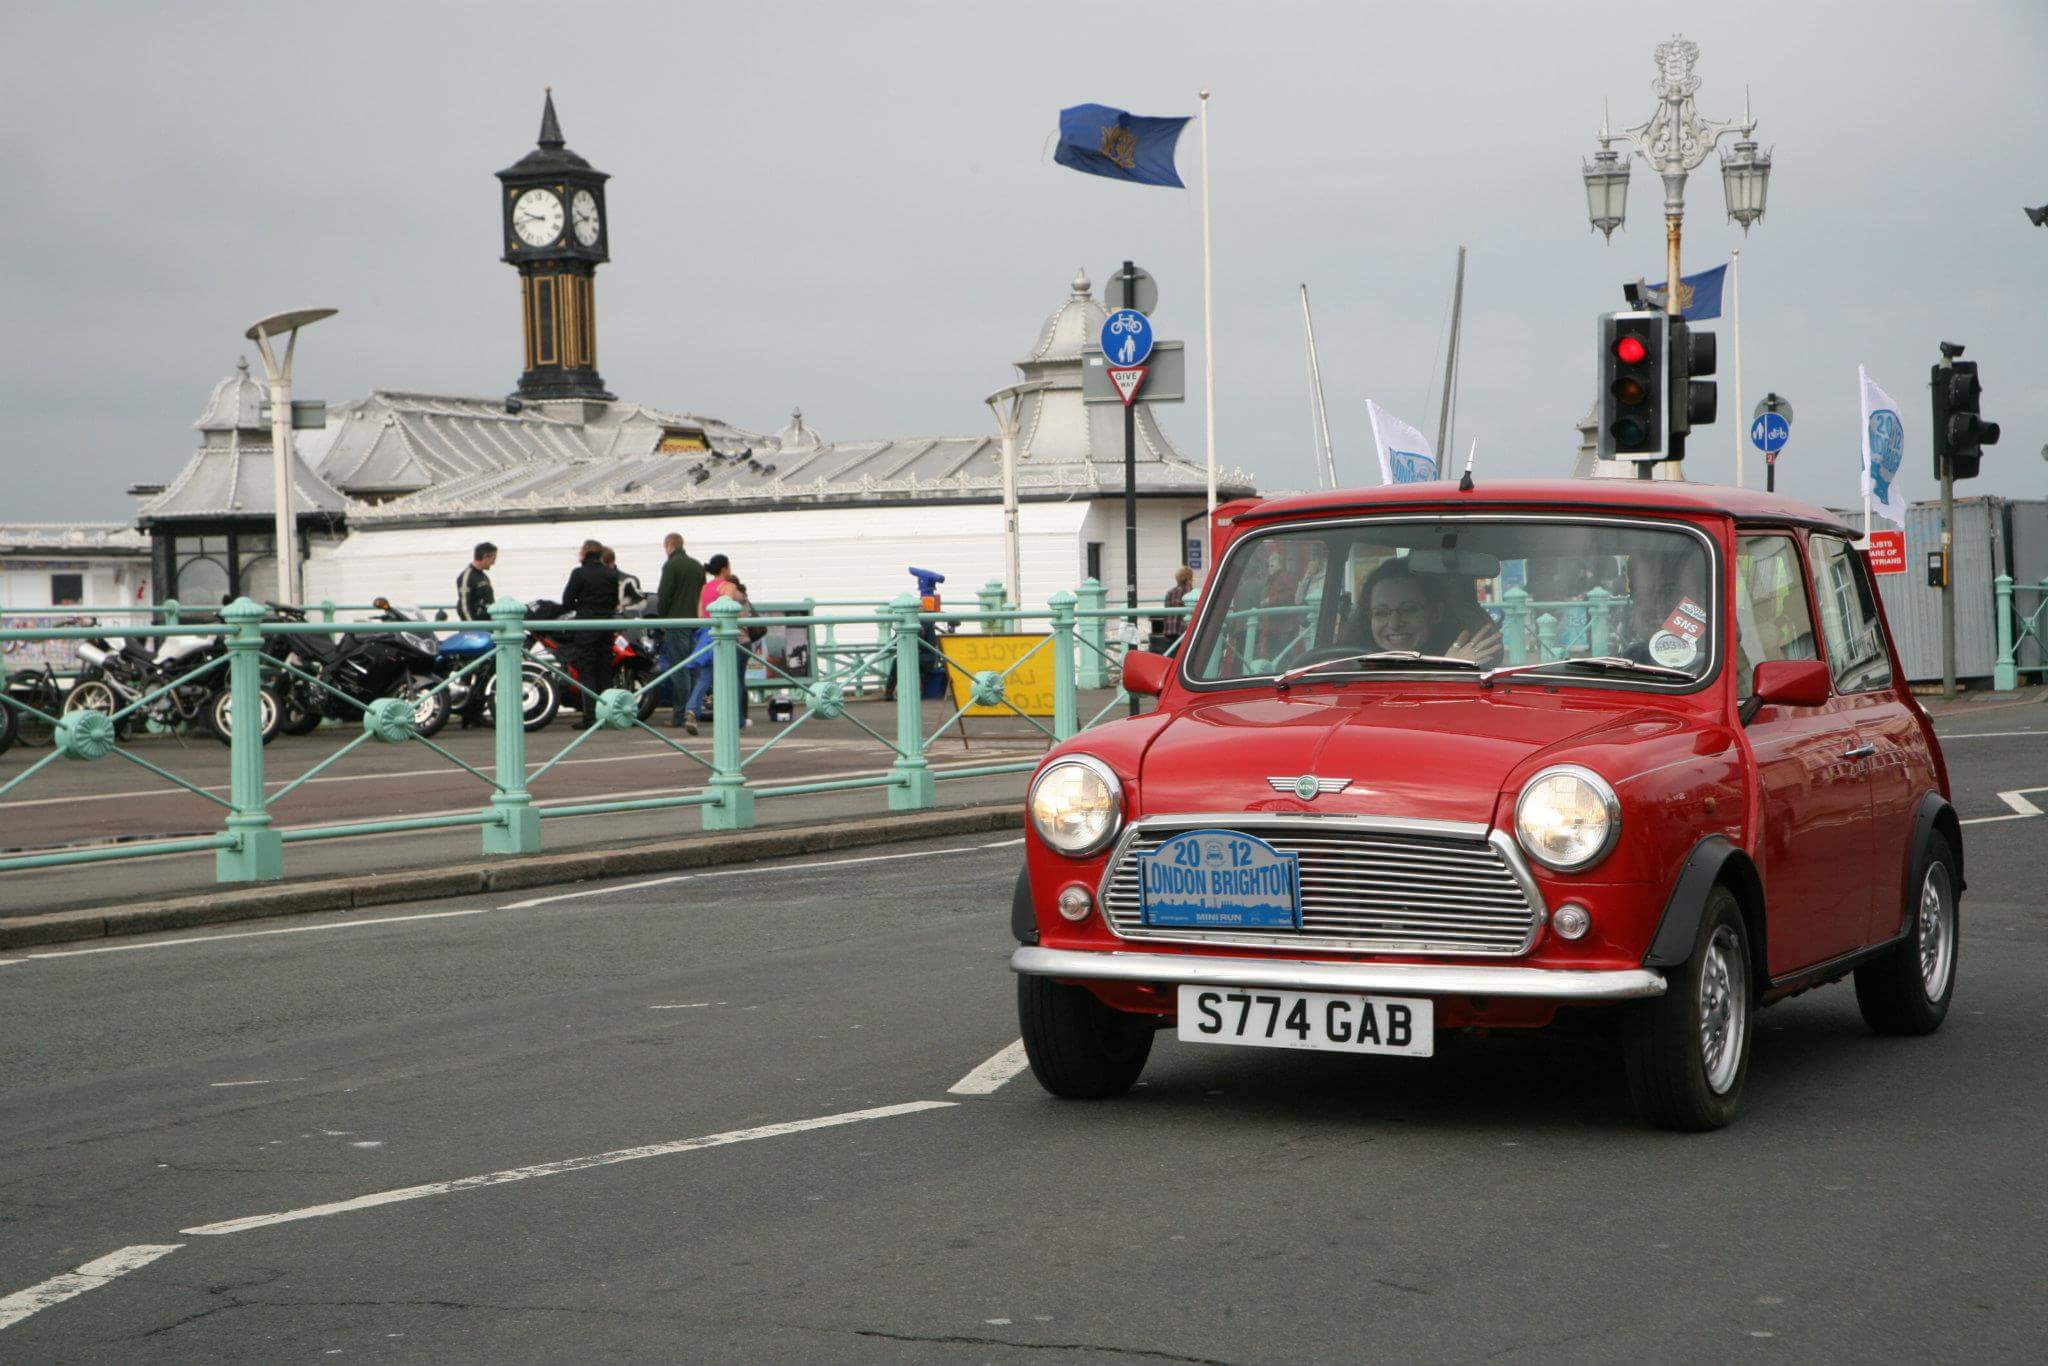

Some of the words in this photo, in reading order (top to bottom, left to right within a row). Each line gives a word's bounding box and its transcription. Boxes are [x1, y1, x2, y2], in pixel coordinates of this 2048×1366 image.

[1870, 540, 1893, 549] LISTS
[1869, 549, 1885, 557] ARE
[1871, 557, 1901, 566] STRIANS
[1174, 839, 1200, 867] 20
[1228, 840, 1252, 867] 12
[1212, 862, 1293, 896] BRIGHTON
[1196, 913, 1218, 921] MINI
[1220, 913, 1242, 921] RUN
[1197, 991, 1311, 1041] S774
[1326, 1000, 1413, 1047] GAB
